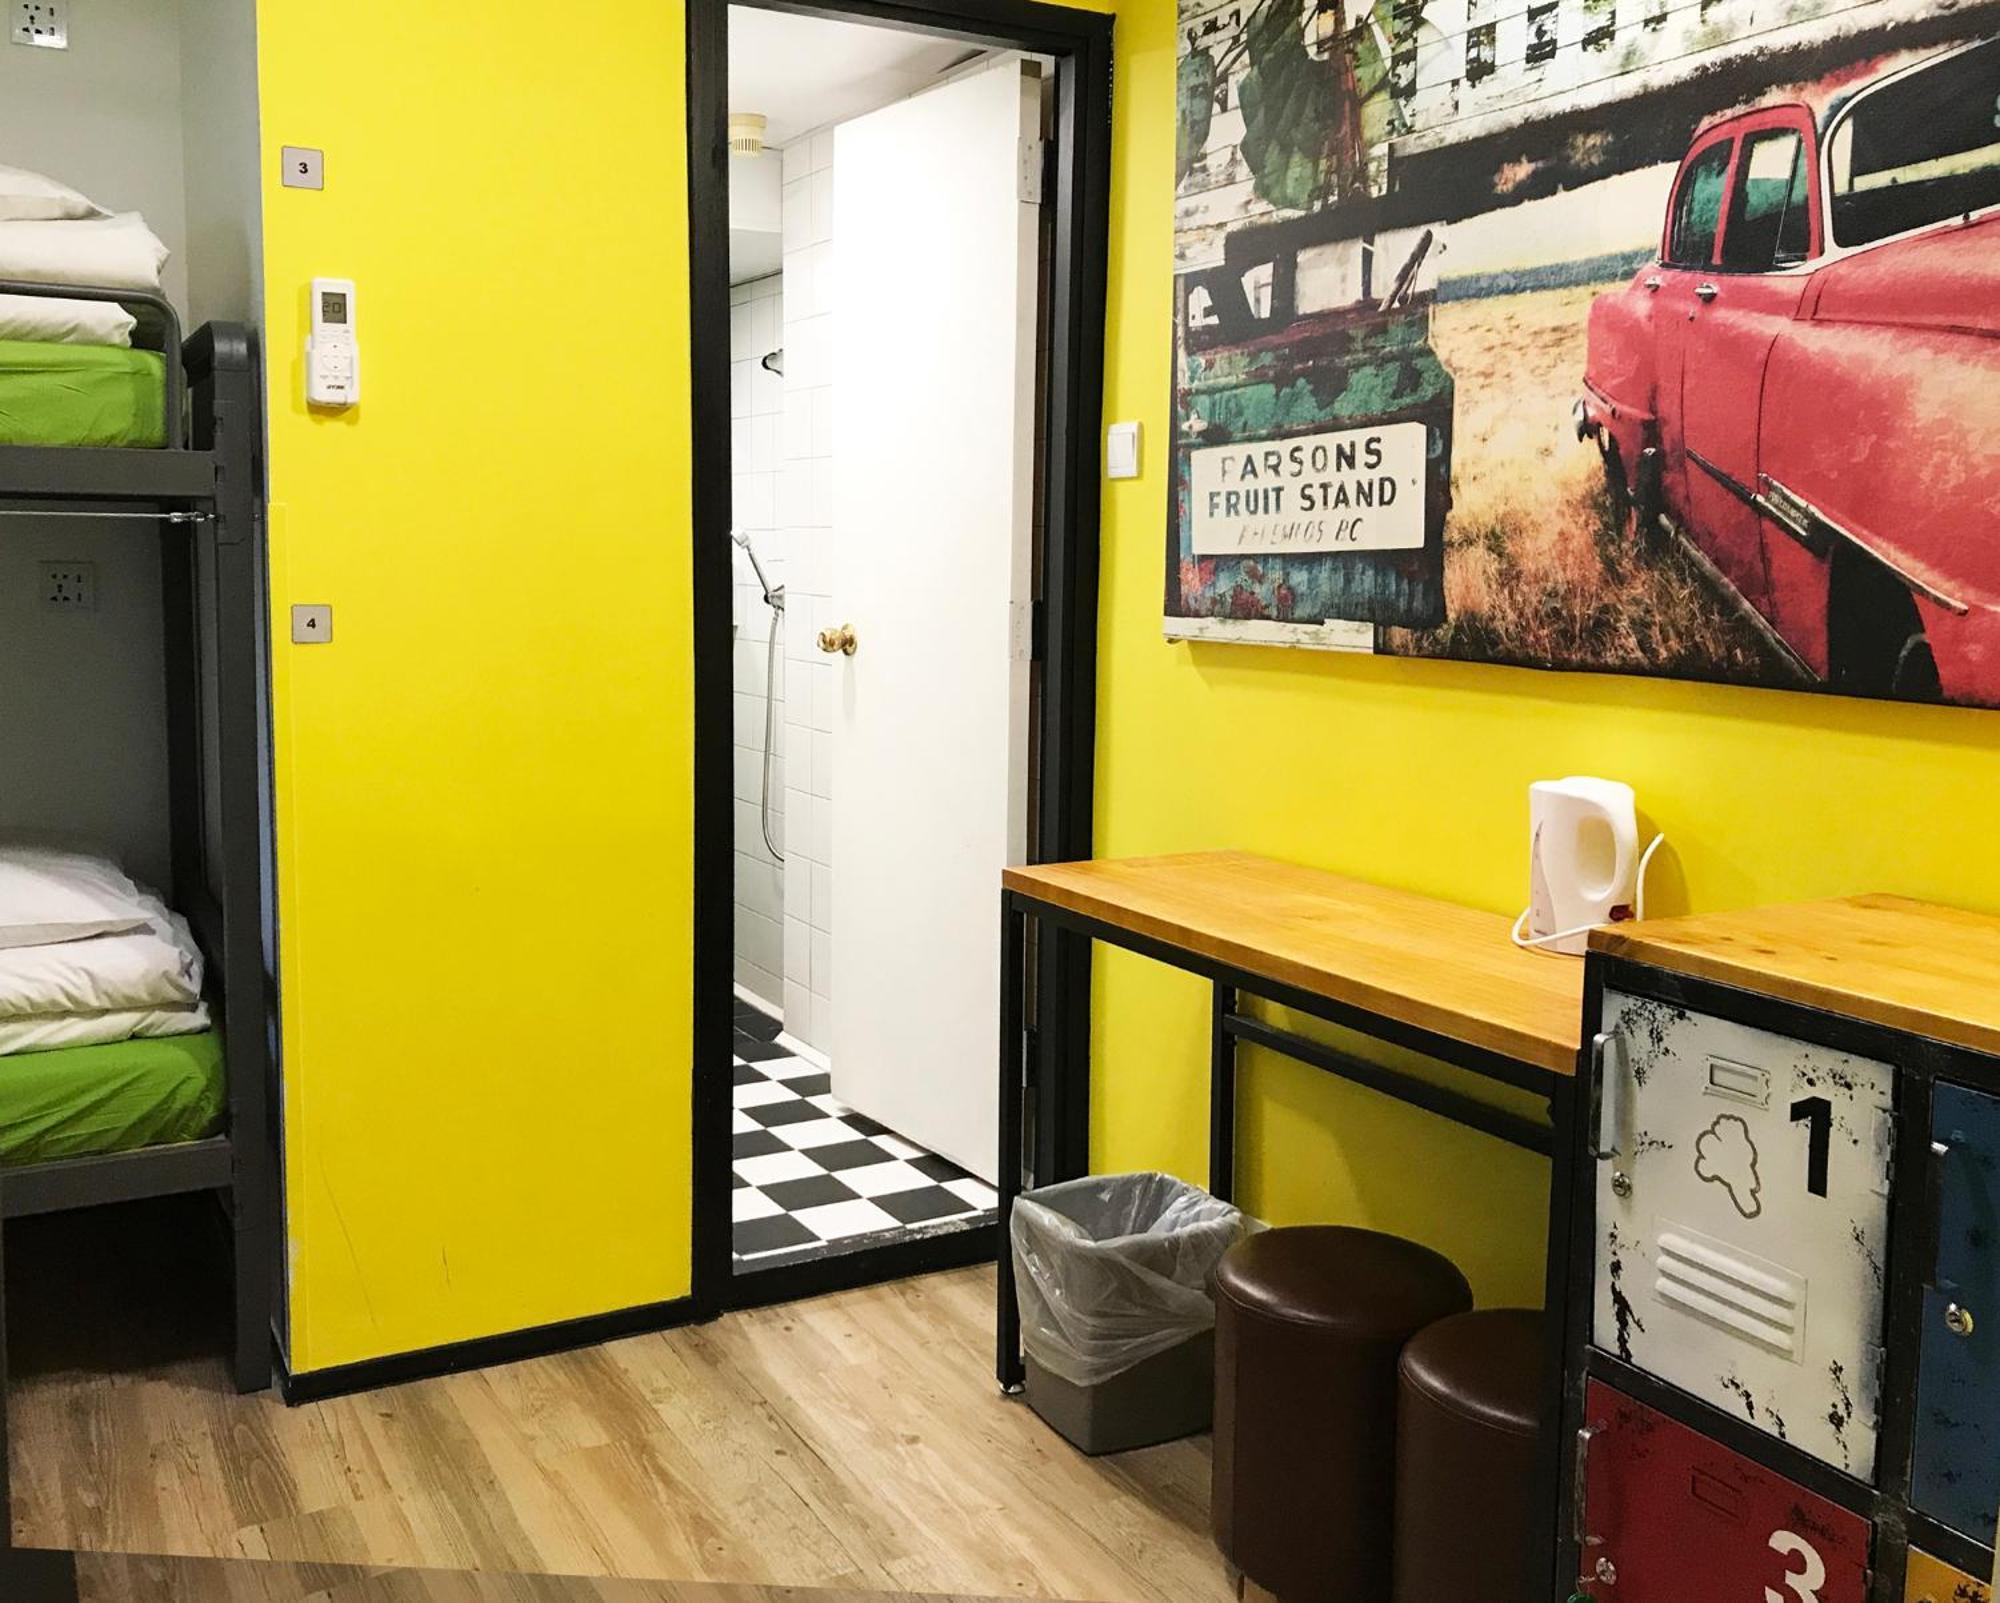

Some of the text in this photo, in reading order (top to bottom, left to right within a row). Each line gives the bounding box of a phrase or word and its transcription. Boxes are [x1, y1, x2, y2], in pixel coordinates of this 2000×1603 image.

[299, 162, 308, 174] 3
[1208, 476, 1397, 518] FRUIT STAND
[306, 618, 316, 629] 4
[1790, 1096, 1831, 1198] 1
[1765, 1529, 1826, 1603] 3
